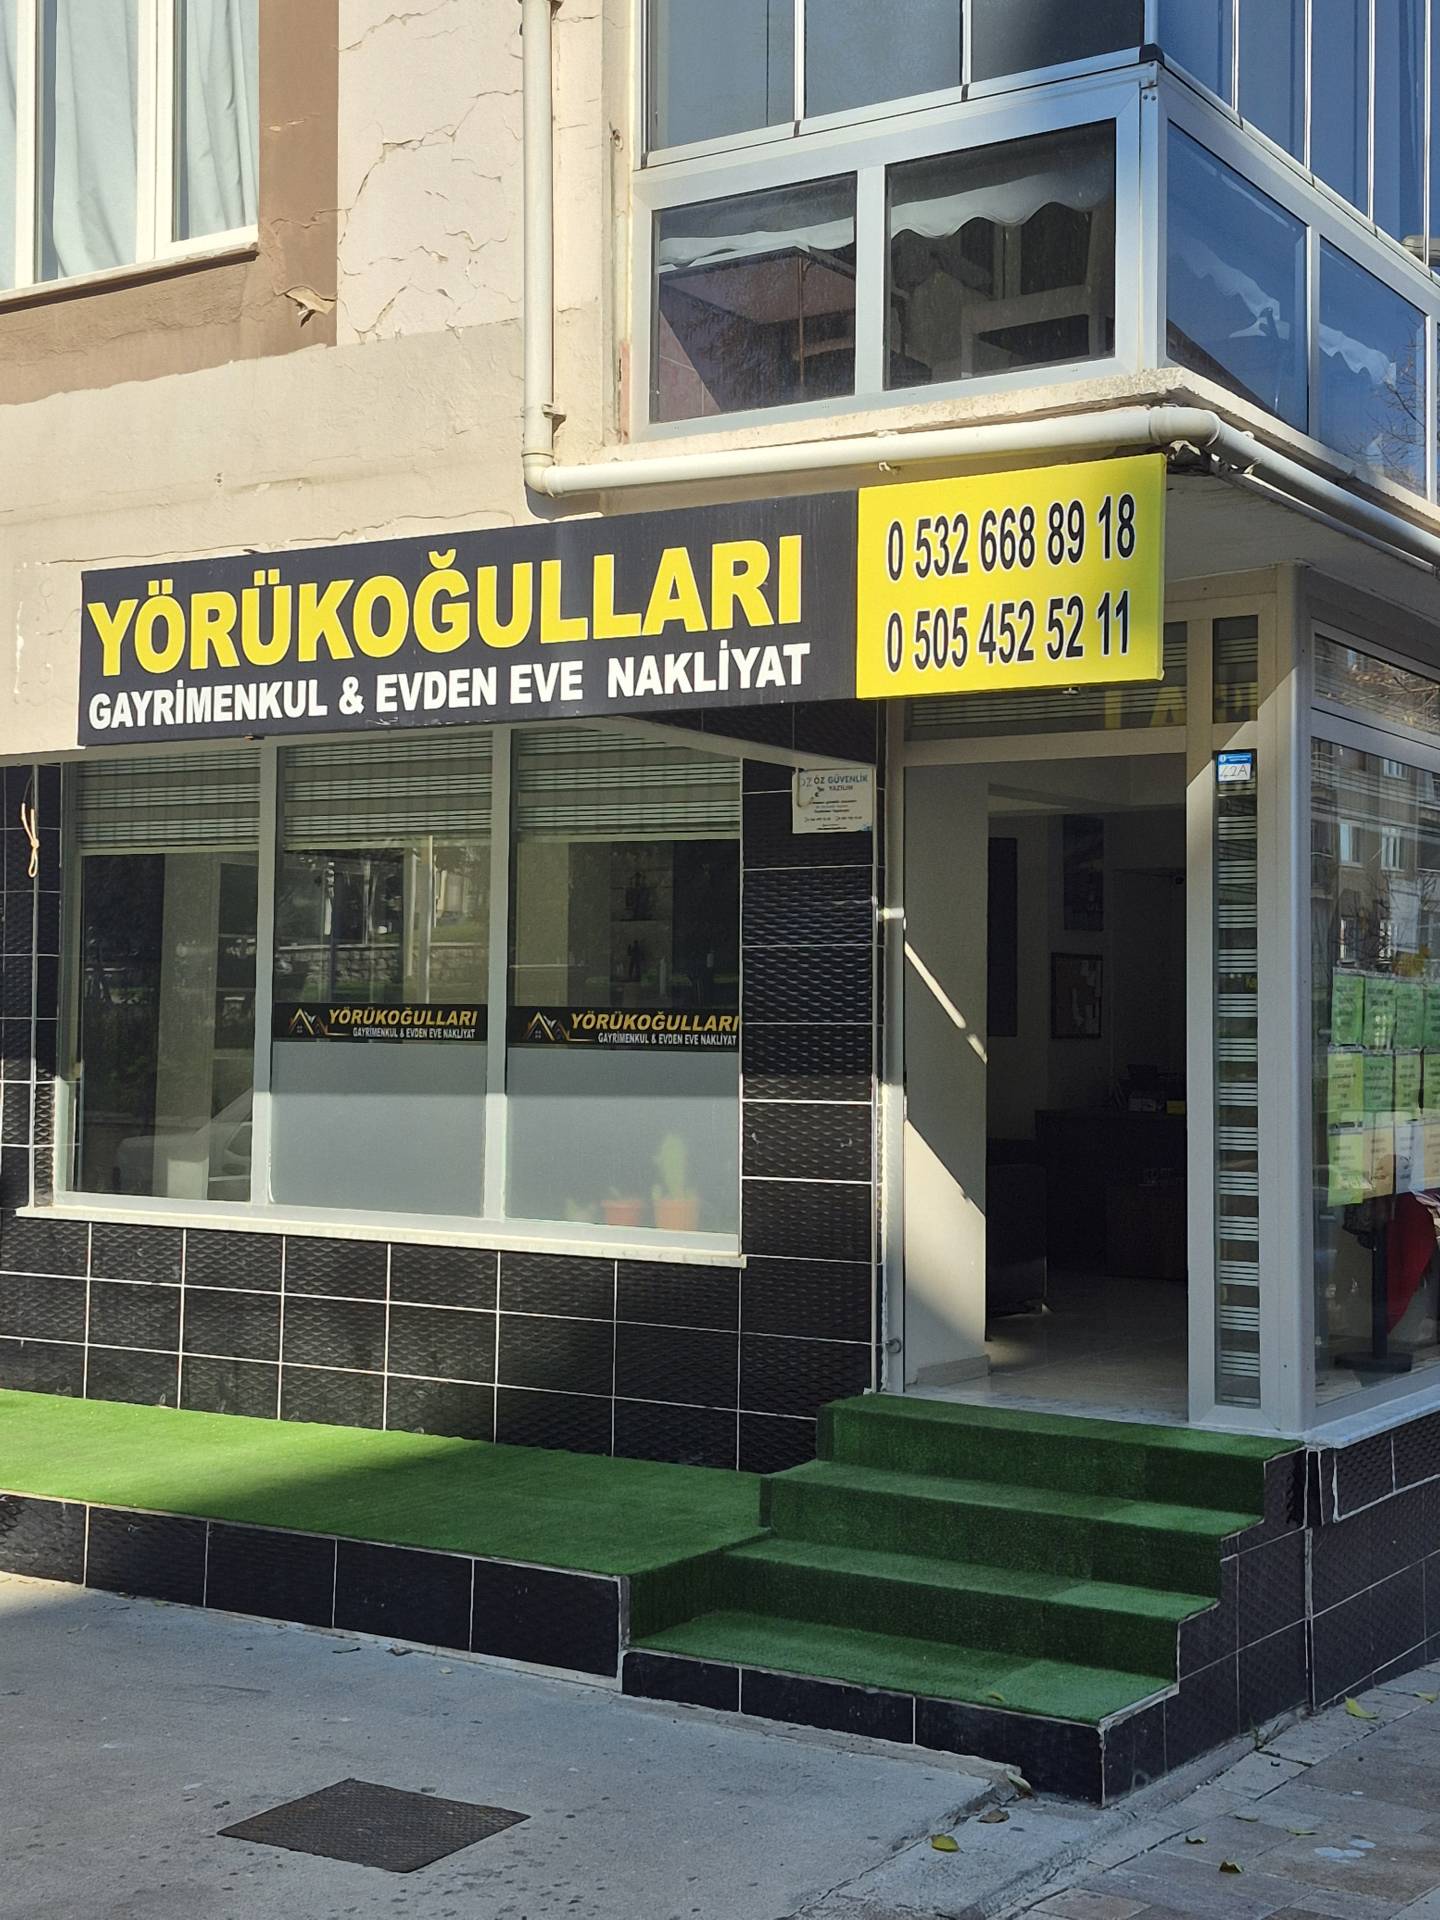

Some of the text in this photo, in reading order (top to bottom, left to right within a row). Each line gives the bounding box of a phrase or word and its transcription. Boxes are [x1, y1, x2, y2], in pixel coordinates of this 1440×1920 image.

[887, 493, 1136, 581] 0 532 668 89 18
[87, 534, 803, 677] YÖRÜKOĞULLARI
[887, 590, 1129, 673] 0 505 452 52 11
[87, 639, 812, 730] GAYRİMENKUL & EVDEN EVE NAKLİYAT
[329, 1006, 478, 1026] YÖRÜKOĞULLARI
[352, 1026, 399, 1038] GAYRİMENKUL
[406, 1028, 428, 1038] EVDEN
[429, 1029, 442, 1039] EVE
[443, 1028, 476, 1039] NAKLİYAT
[571, 1011, 740, 1032] YÖRÜKOĞULLARI
[598, 1031, 650, 1044] GAYRİMENKUL
[658, 1033, 683, 1045] EVDEN
[685, 1034, 699, 1045] EVE
[700, 1033, 737, 1046] NAKLİYAT
